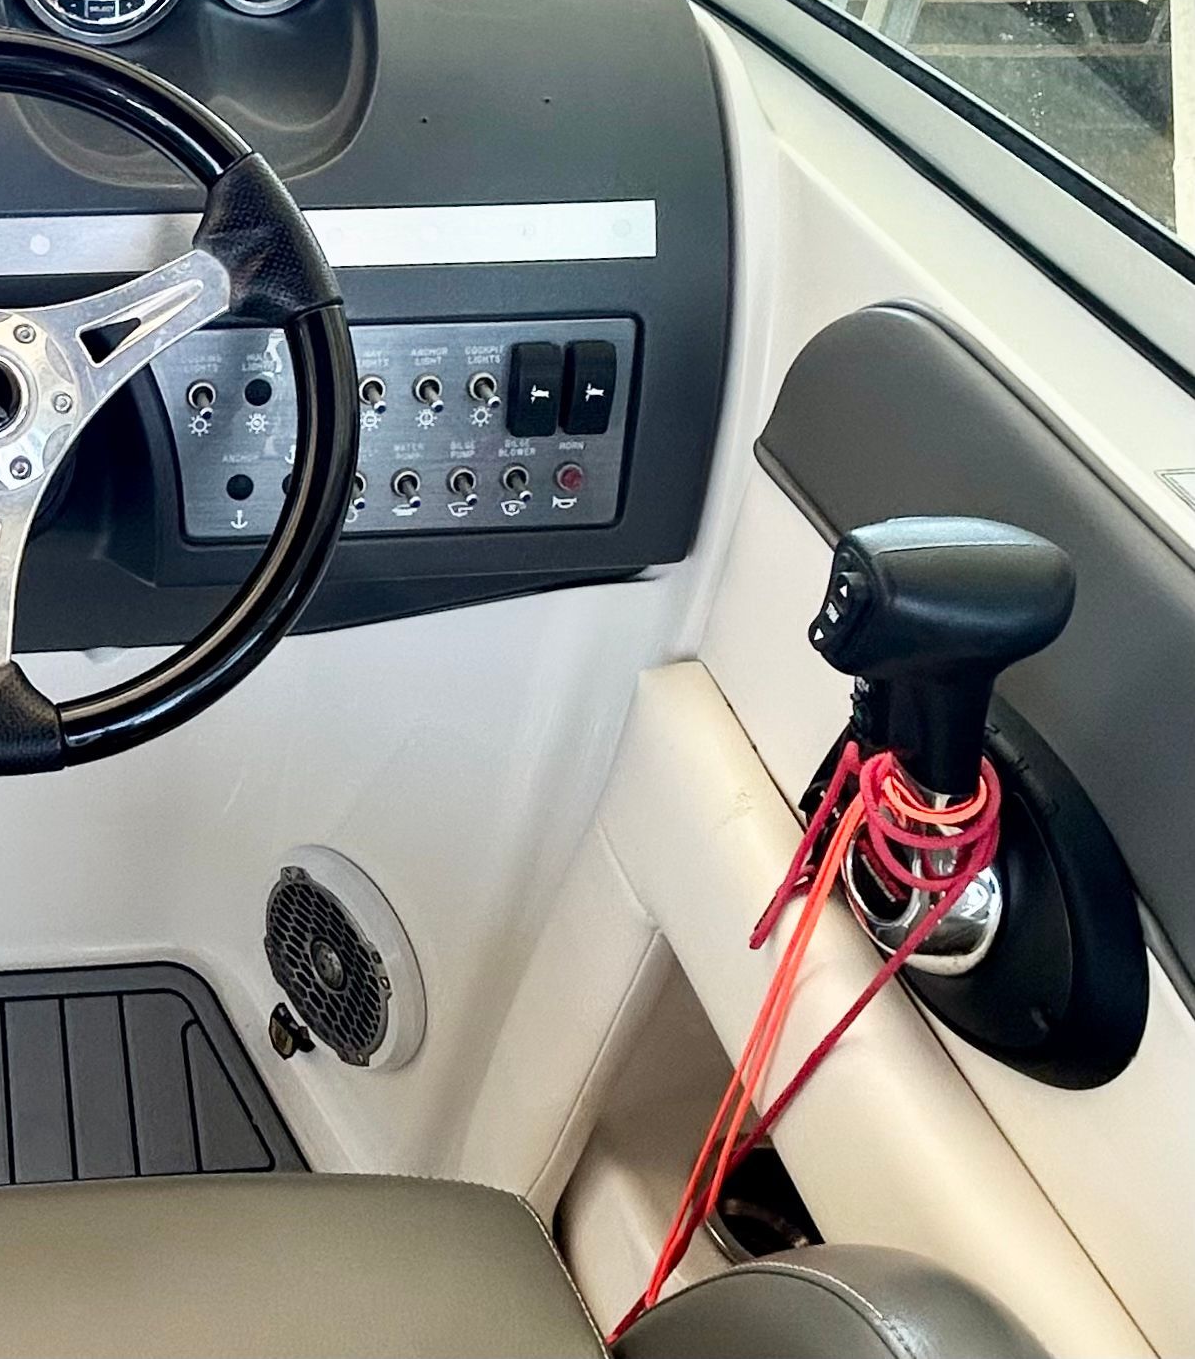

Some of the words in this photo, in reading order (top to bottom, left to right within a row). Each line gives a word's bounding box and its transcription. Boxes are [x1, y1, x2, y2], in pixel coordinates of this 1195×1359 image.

[410, 346, 449, 356] ANCHOR
[464, 345, 504, 355] COCKPIT
[414, 357, 442, 367] LIGHT
[467, 355, 501, 365] LIGHTS
[558, 442, 585, 451] HORN
[450, 450, 475, 459] PUMP
[498, 448, 536, 457] BLOWER
